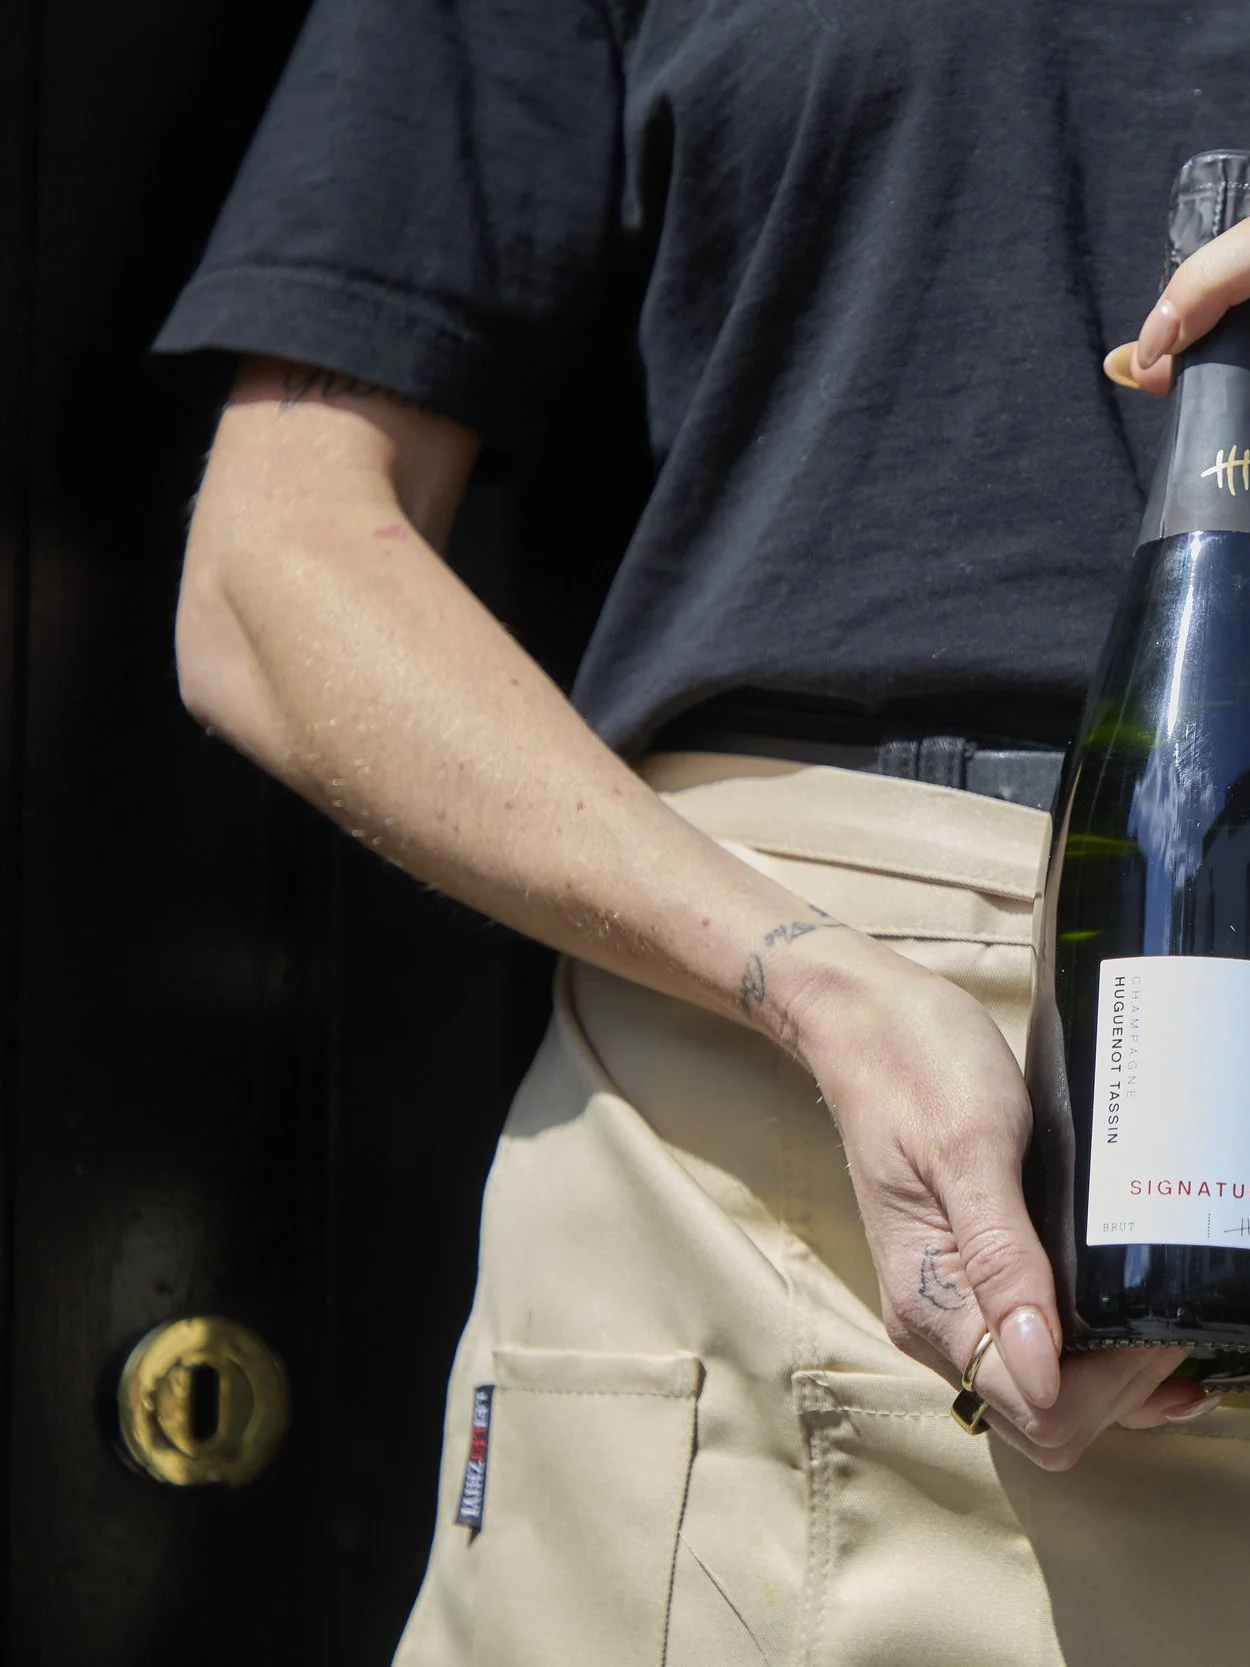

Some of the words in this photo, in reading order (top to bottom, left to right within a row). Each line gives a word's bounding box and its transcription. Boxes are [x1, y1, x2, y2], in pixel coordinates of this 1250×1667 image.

[1110, 976, 1126, 1073] HUGUENOT
[1126, 976, 1142, 1099] CHAMPAGNE
[1106, 1081, 1121, 1144] TASSIN
[1102, 1222, 1136, 1233] BRUT
